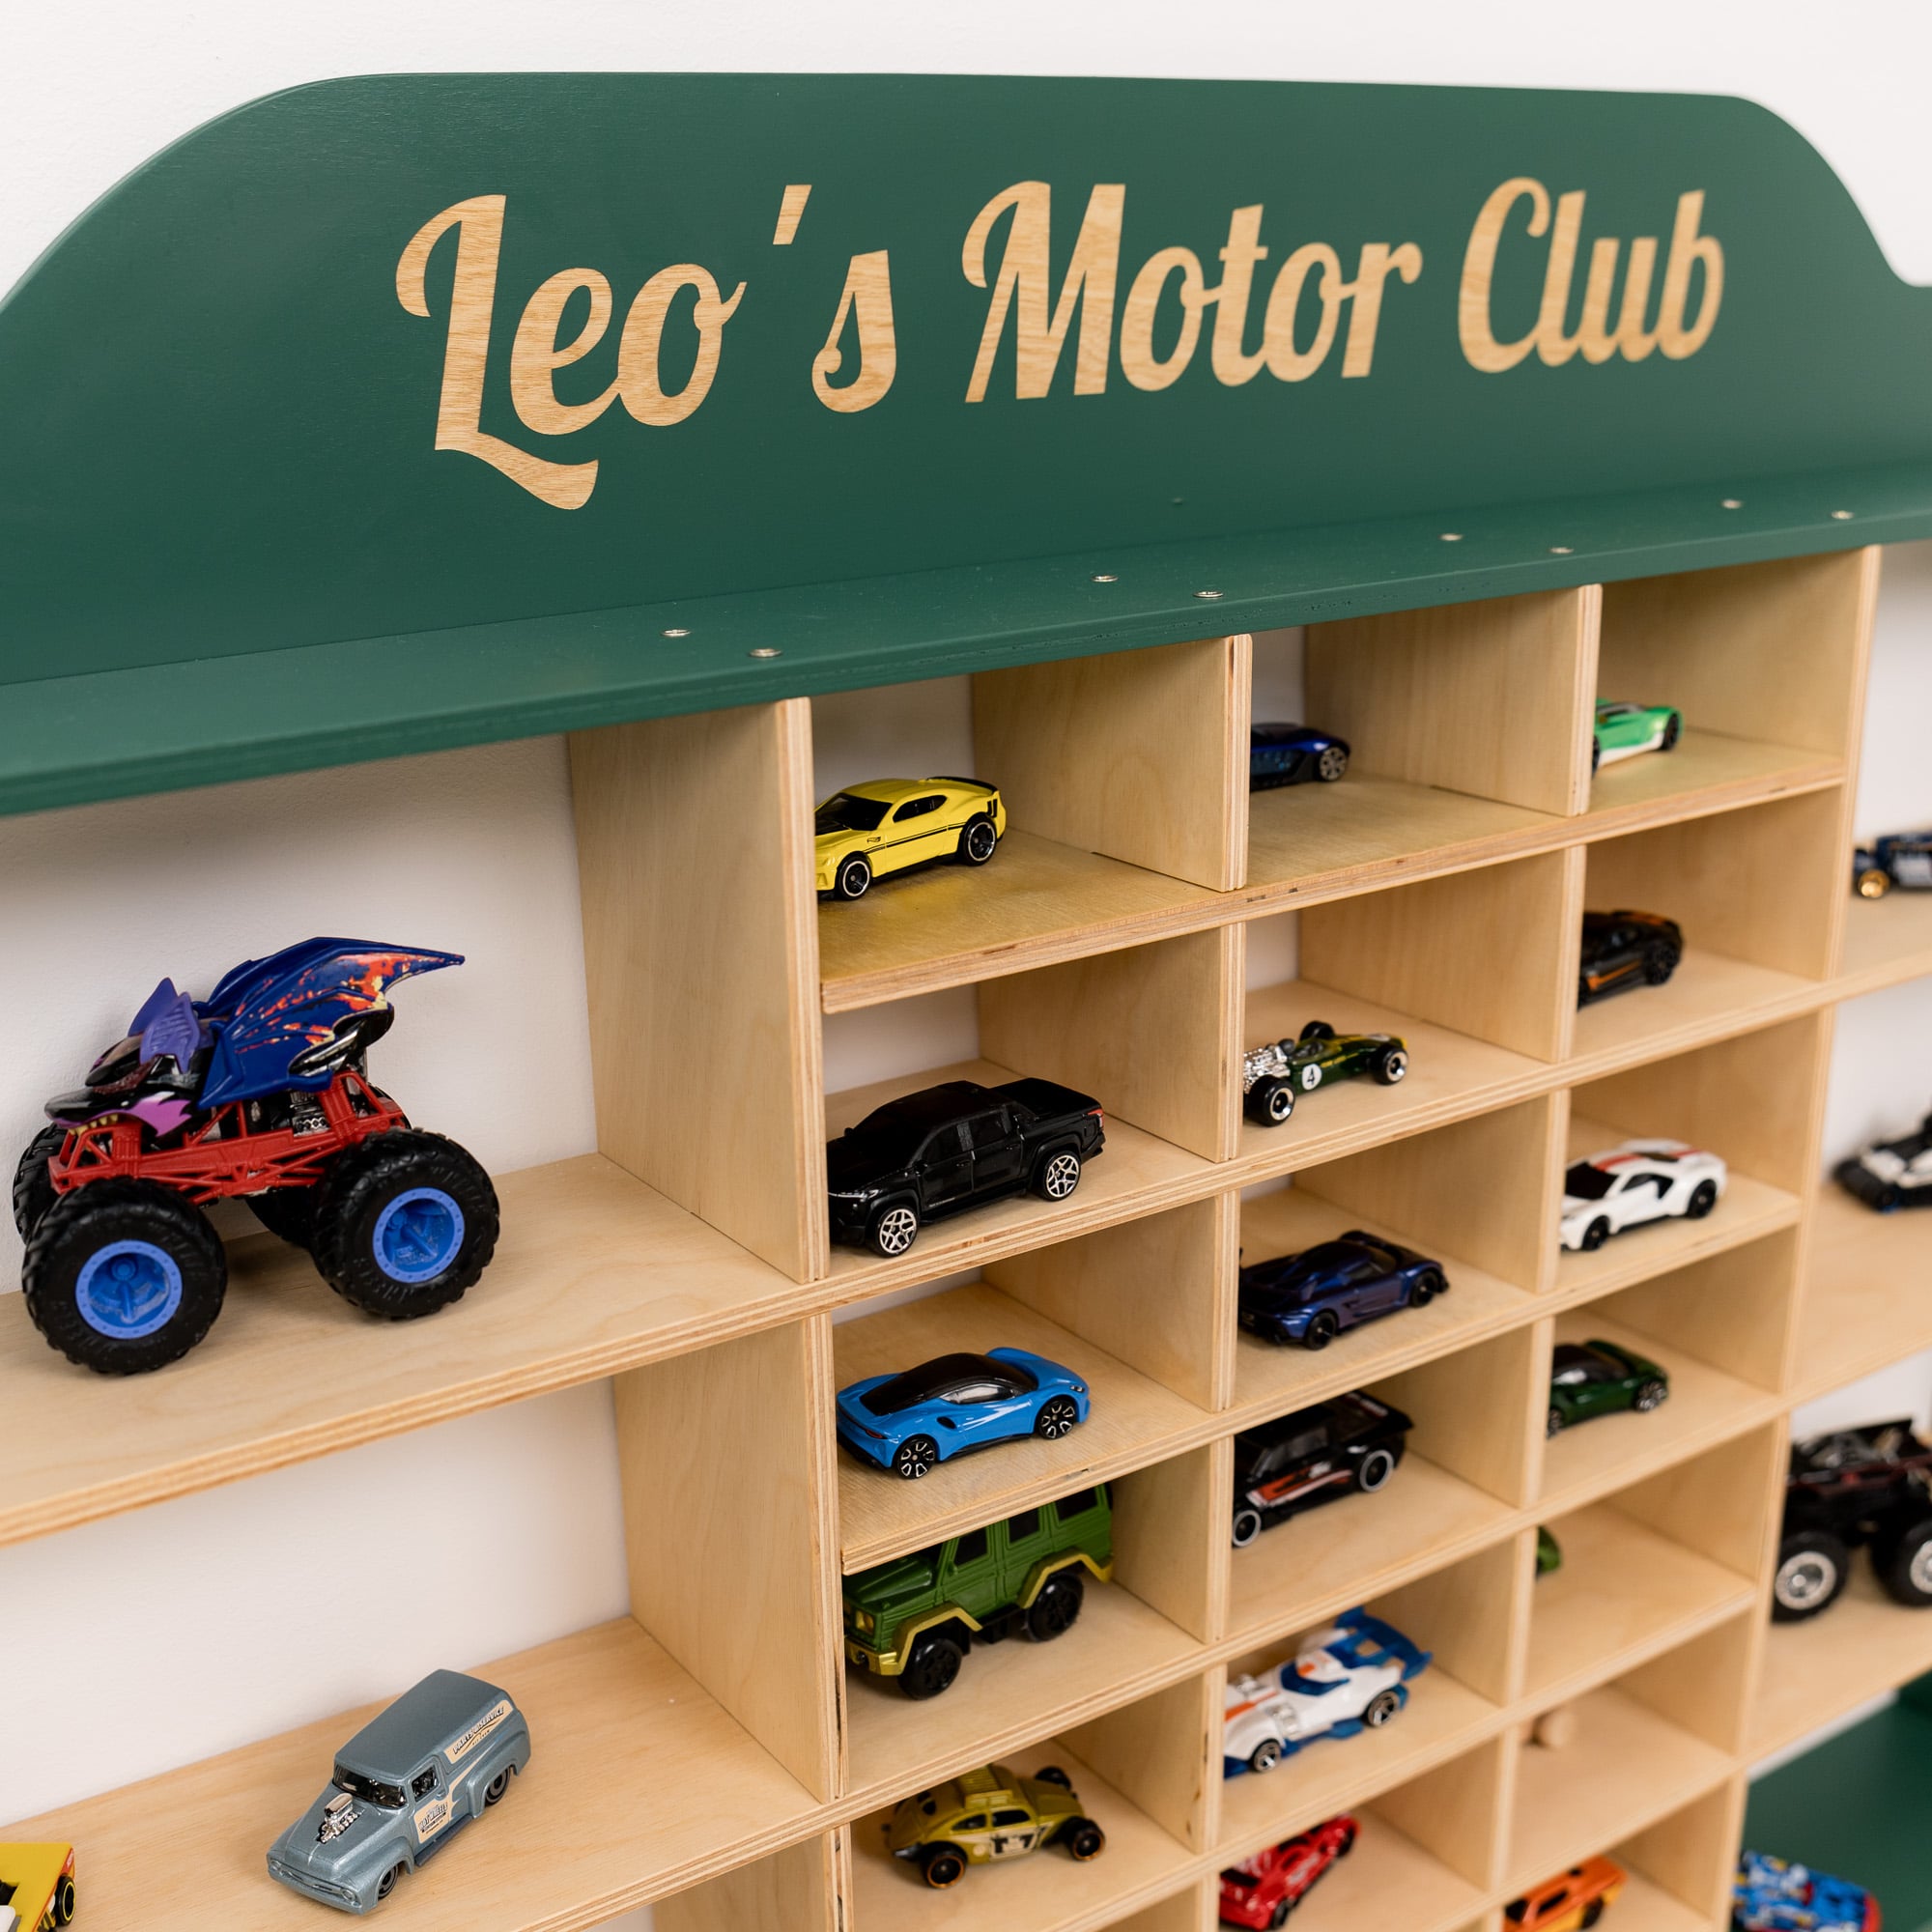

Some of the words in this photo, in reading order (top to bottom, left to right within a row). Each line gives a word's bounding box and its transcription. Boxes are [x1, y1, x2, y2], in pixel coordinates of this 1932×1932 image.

[395, 185, 896, 509] Leo's
[962, 181, 1422, 402] Motor
[1459, 178, 1723, 372] Club
[1307, 1067, 1315, 1085] 4
